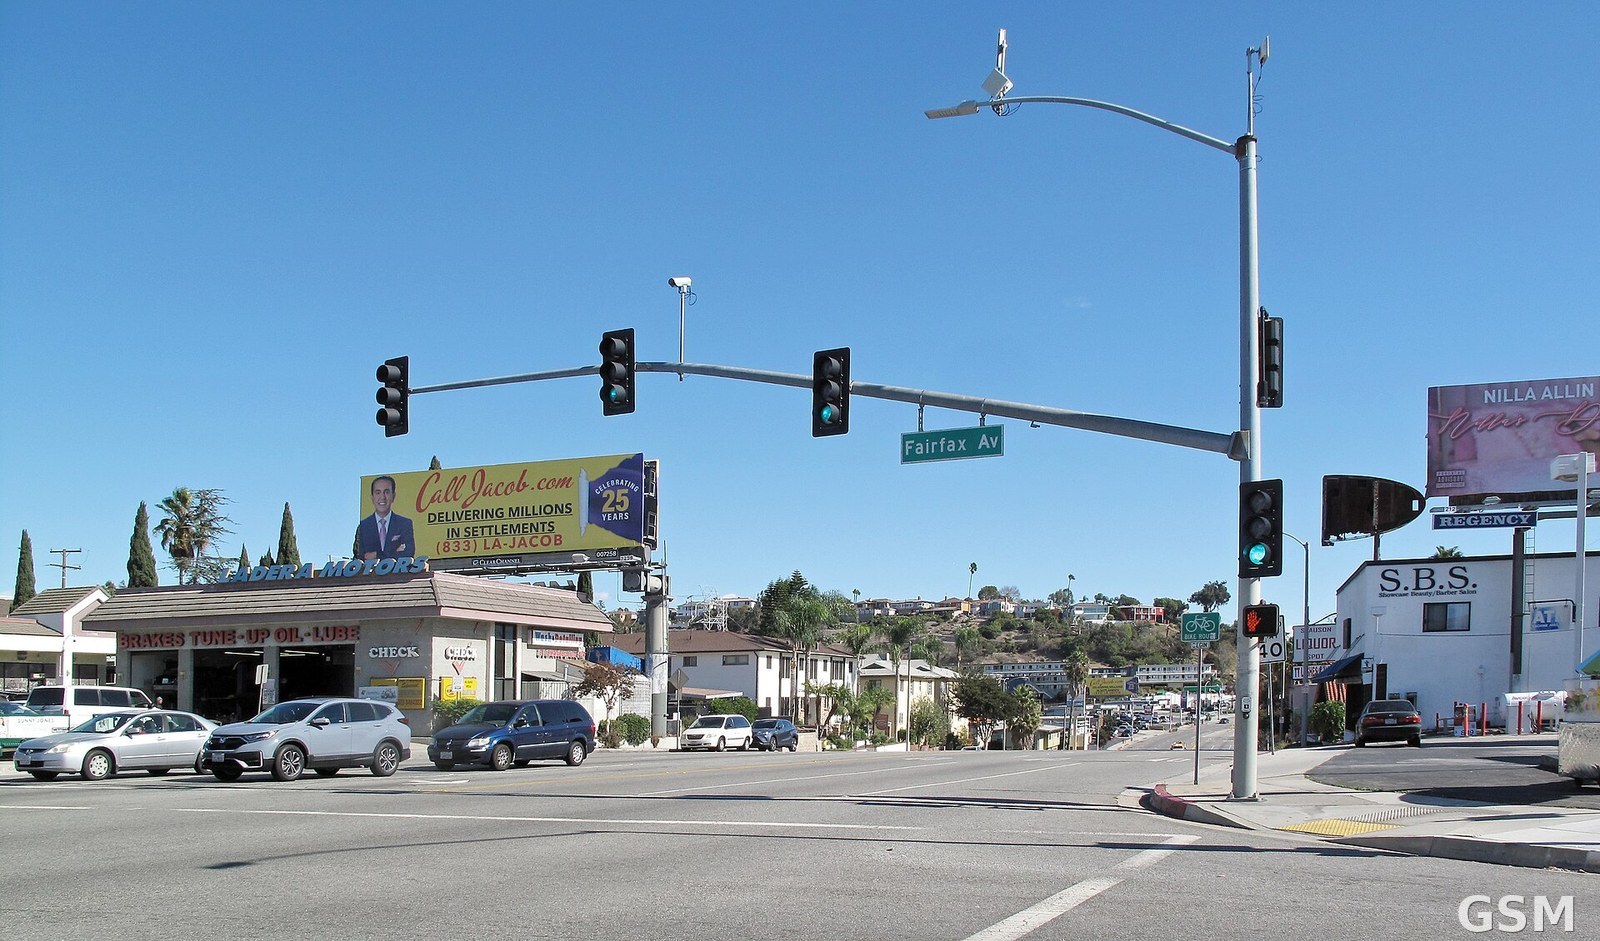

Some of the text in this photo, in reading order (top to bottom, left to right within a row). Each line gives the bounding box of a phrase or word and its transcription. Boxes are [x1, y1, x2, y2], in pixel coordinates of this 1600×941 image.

[1484, 383, 1594, 403] NILLA ALLIN
[905, 434, 998, 456] Fairfax Av
[415, 468, 574, 513] Call Jacob.com
[595, 479, 640, 495] CELEBRATING
[602, 489, 630, 512] 25
[427, 503, 572, 524] DELIVERING MILLIONS
[602, 513, 630, 521] YEARS
[1439, 514, 1532, 527] REGENCY
[447, 521, 555, 539] IN SETTLEMENTS
[436, 534, 563, 554] (833) LA-JACOB
[219, 555, 430, 583] LADERA MOTORS
[1380, 566, 1477, 592] S.B.S.
[119, 632, 186, 649] BRAKES
[1260, 642, 1283, 658] 40
[368, 646, 420, 658] CHECK
[445, 645, 478, 660] CHECK
